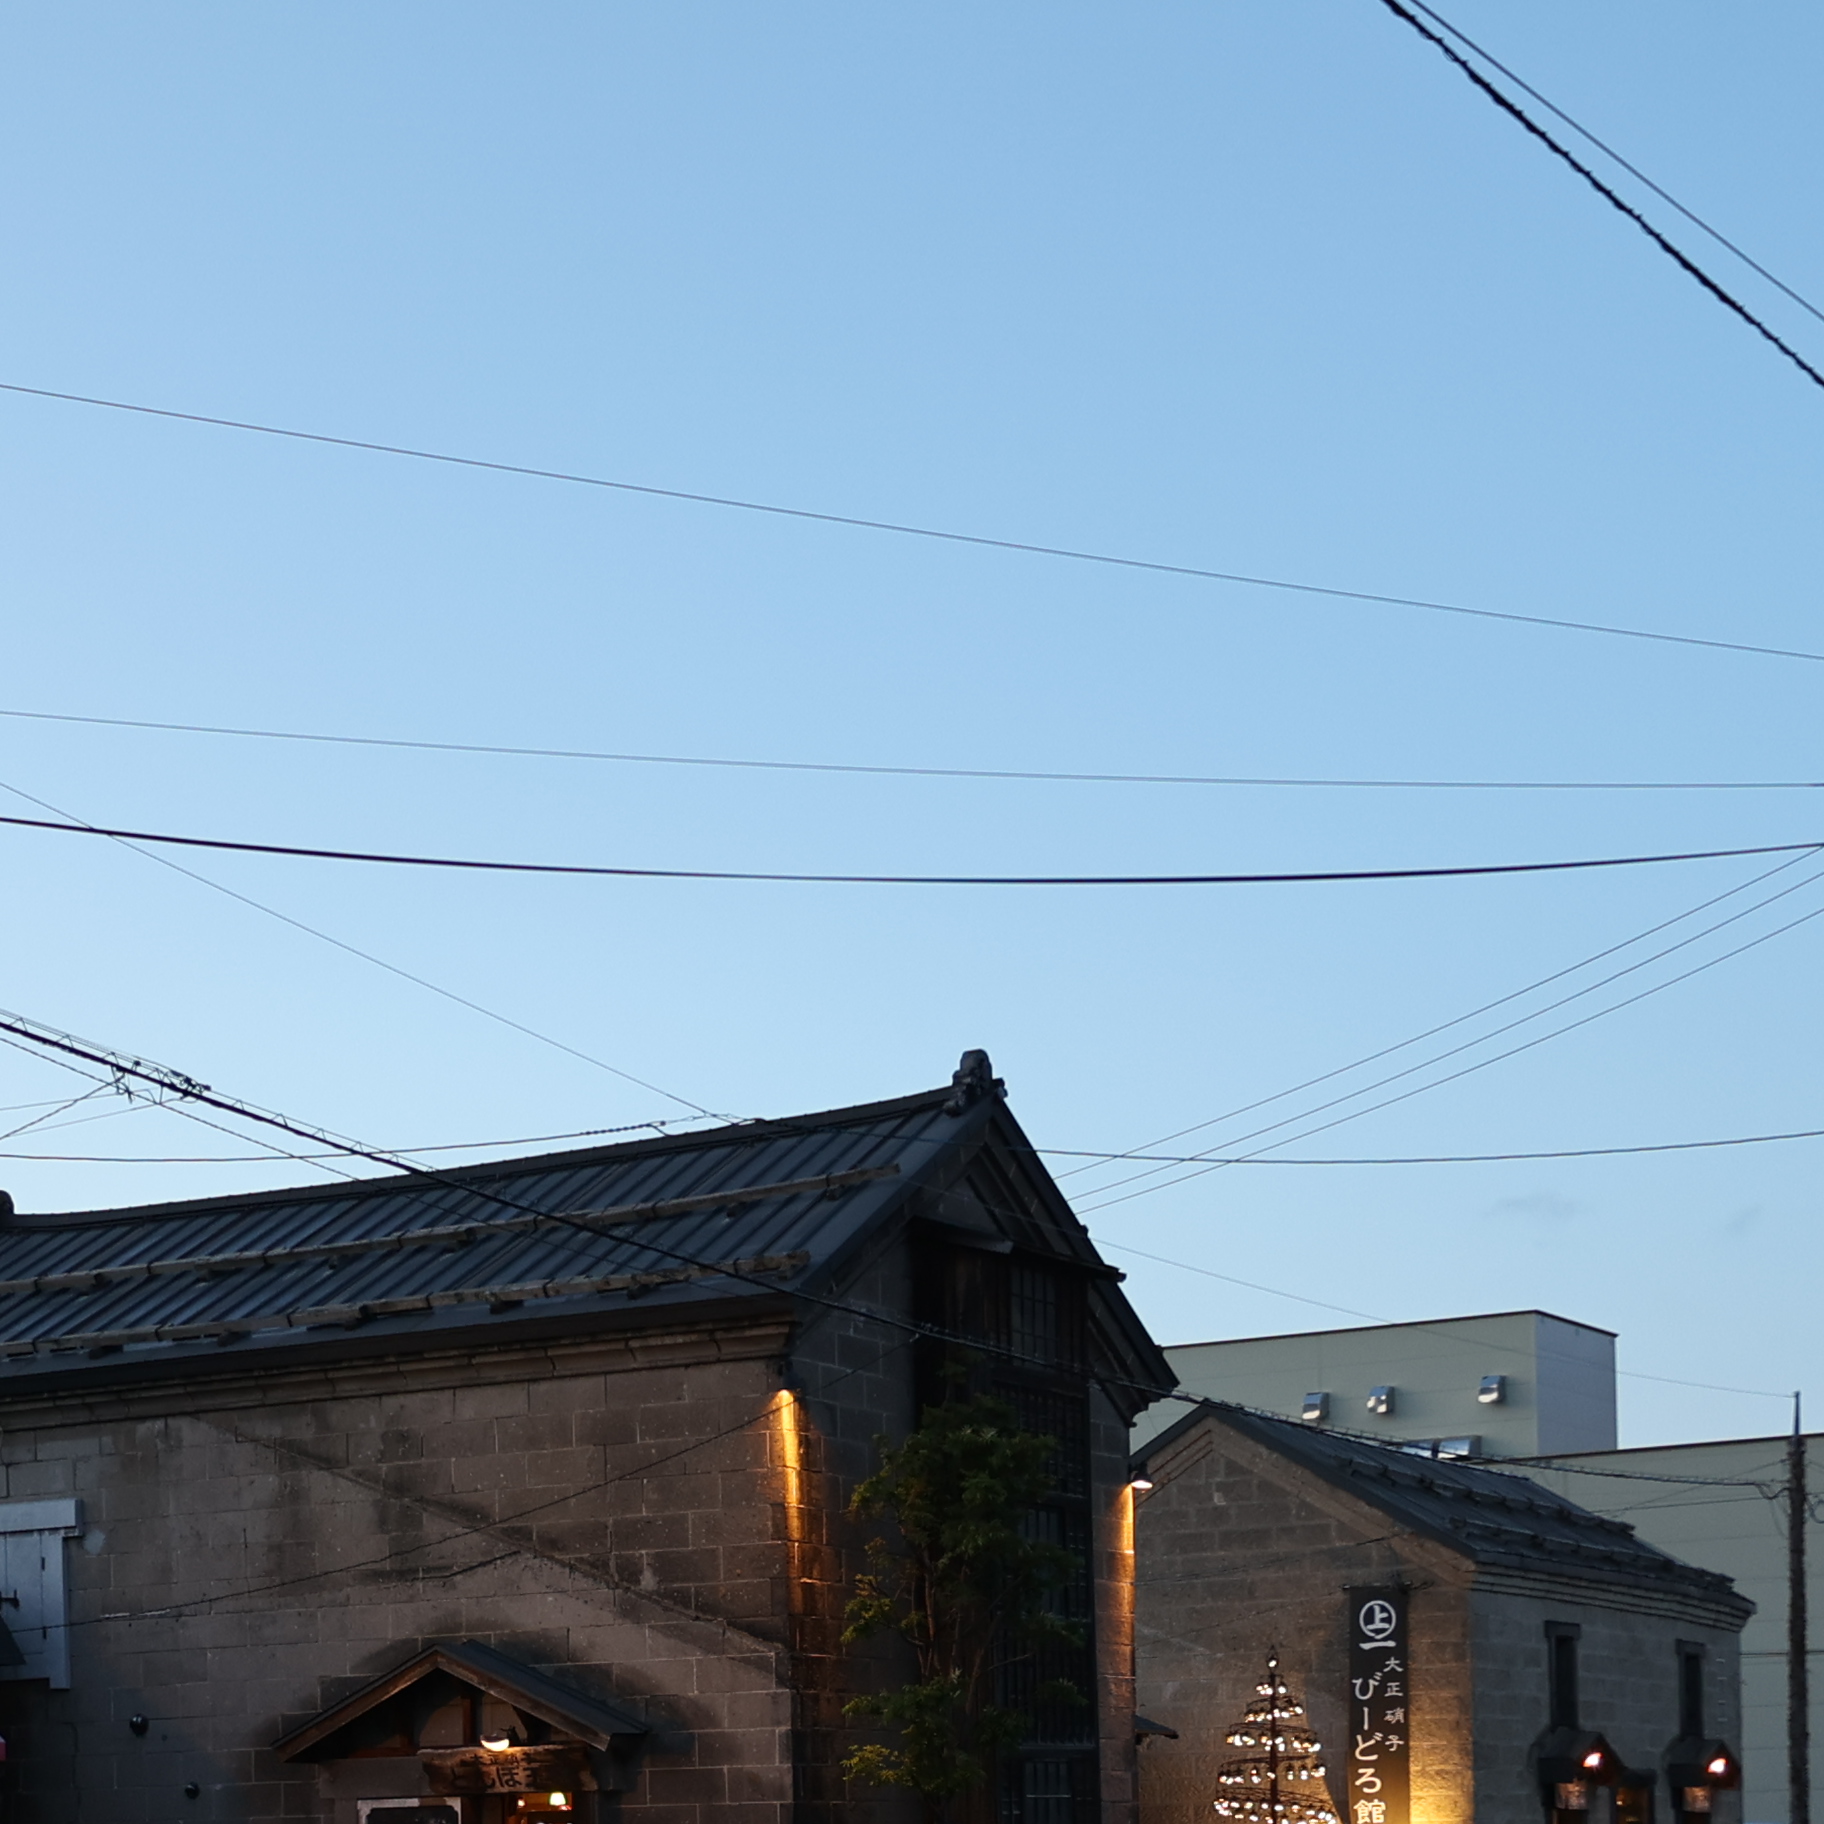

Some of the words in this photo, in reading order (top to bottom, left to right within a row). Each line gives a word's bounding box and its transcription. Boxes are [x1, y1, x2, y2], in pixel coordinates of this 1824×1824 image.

[1351, 1671, 1387, 1824] びーどろ館
[1383, 1656, 1405, 1752] 大正硝子
